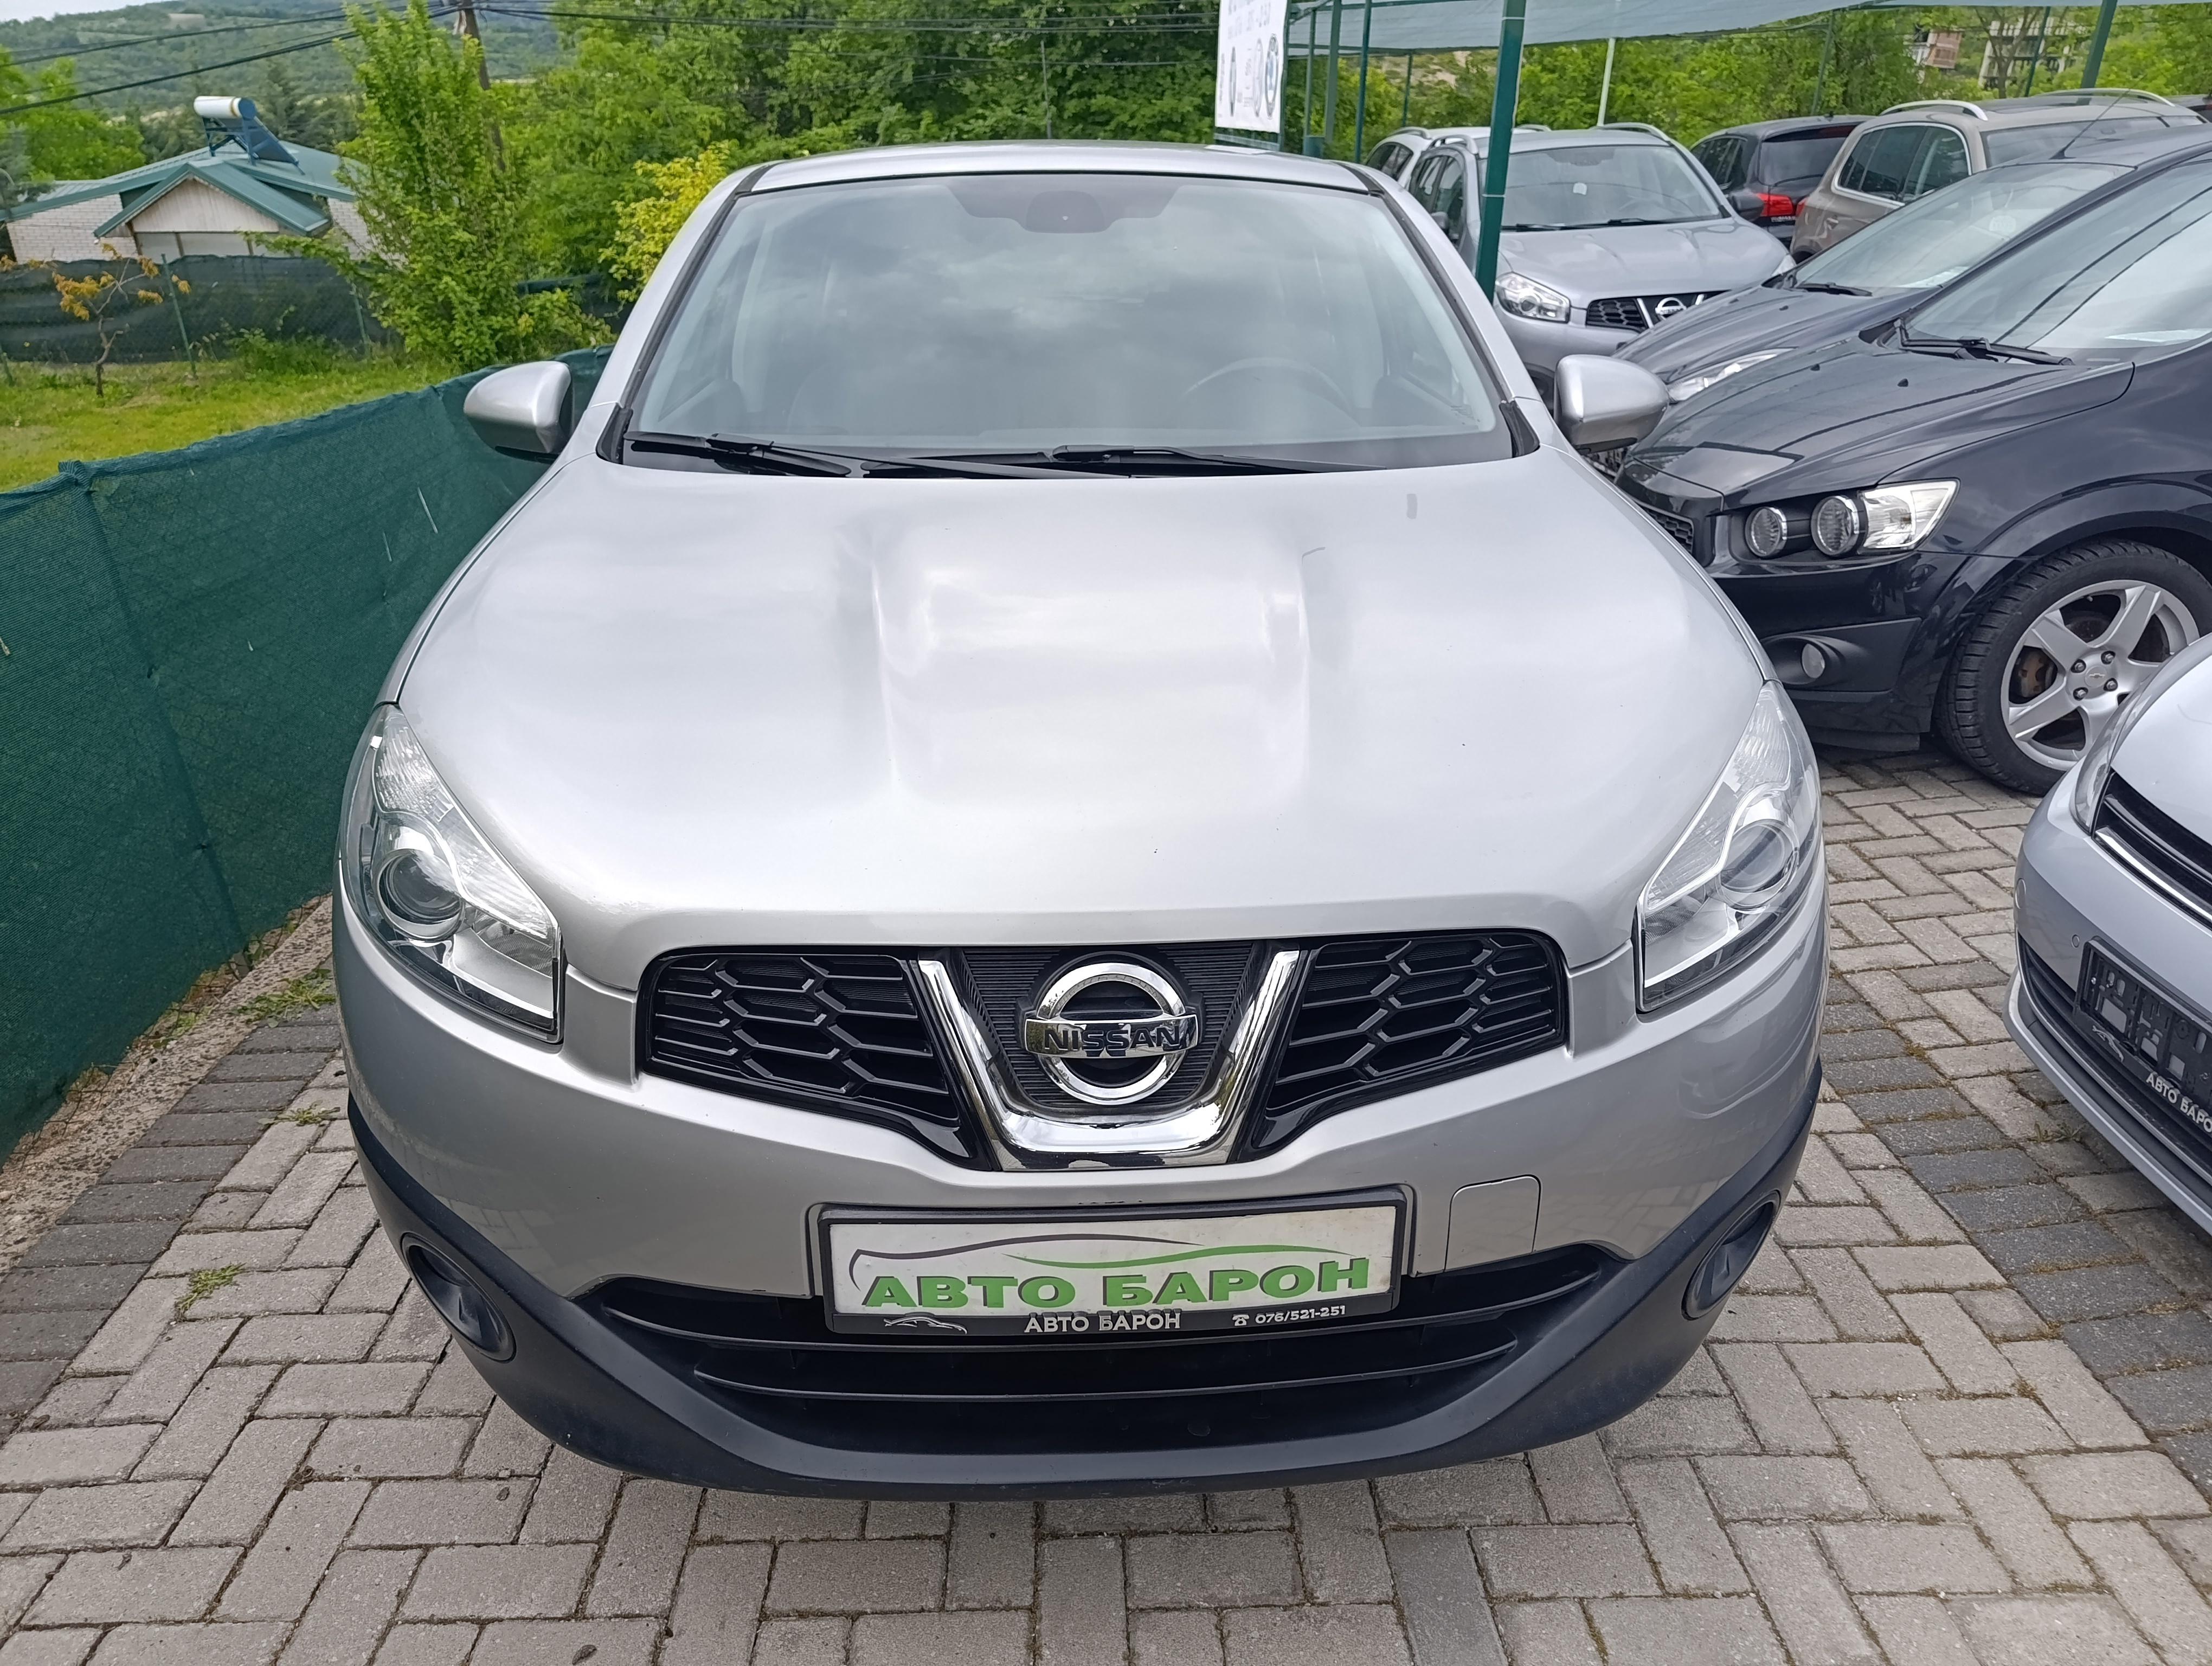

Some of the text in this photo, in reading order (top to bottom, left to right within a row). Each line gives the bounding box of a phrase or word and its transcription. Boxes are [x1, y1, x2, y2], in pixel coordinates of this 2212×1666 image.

[1044, 1026, 1180, 1051] NISSAN
[2146, 1072, 2179, 1104] АВТО
[861, 1257, 1369, 1308] АВТО БАРОН
[1024, 1312, 1181, 1333] АВТО БАРОН
[1255, 1305, 1346, 1324] 076/521-251
